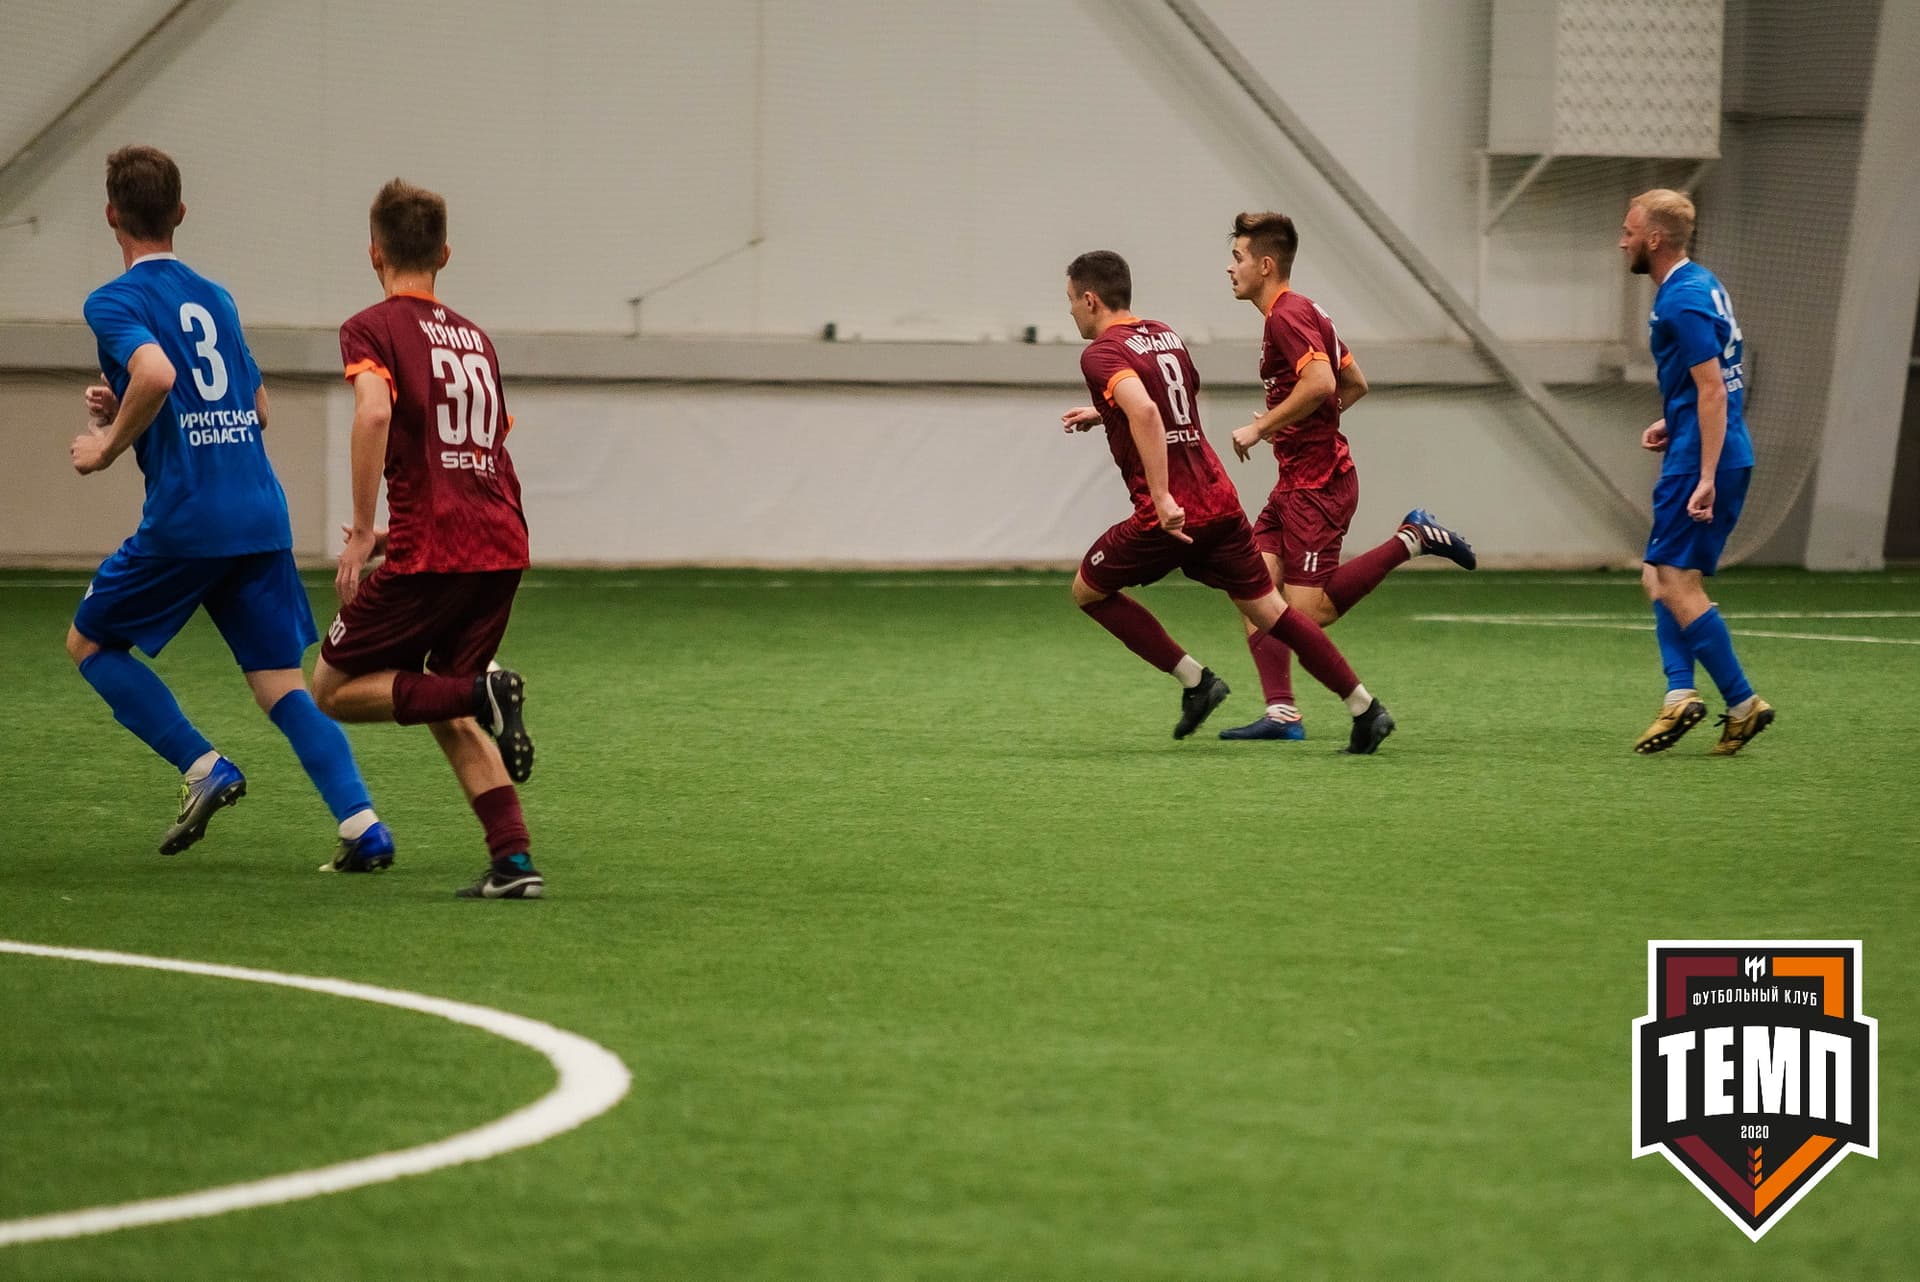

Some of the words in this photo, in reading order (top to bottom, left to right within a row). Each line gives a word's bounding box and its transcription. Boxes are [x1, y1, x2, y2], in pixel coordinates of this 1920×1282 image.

[179, 302, 228, 401] 3
[418, 319, 484, 353] ЧЕРНОВ
[431, 347, 498, 449] 30
[1156, 352, 1192, 425] 8
[1091, 550, 1105, 566] 8
[1303, 551, 1318, 572] 11
